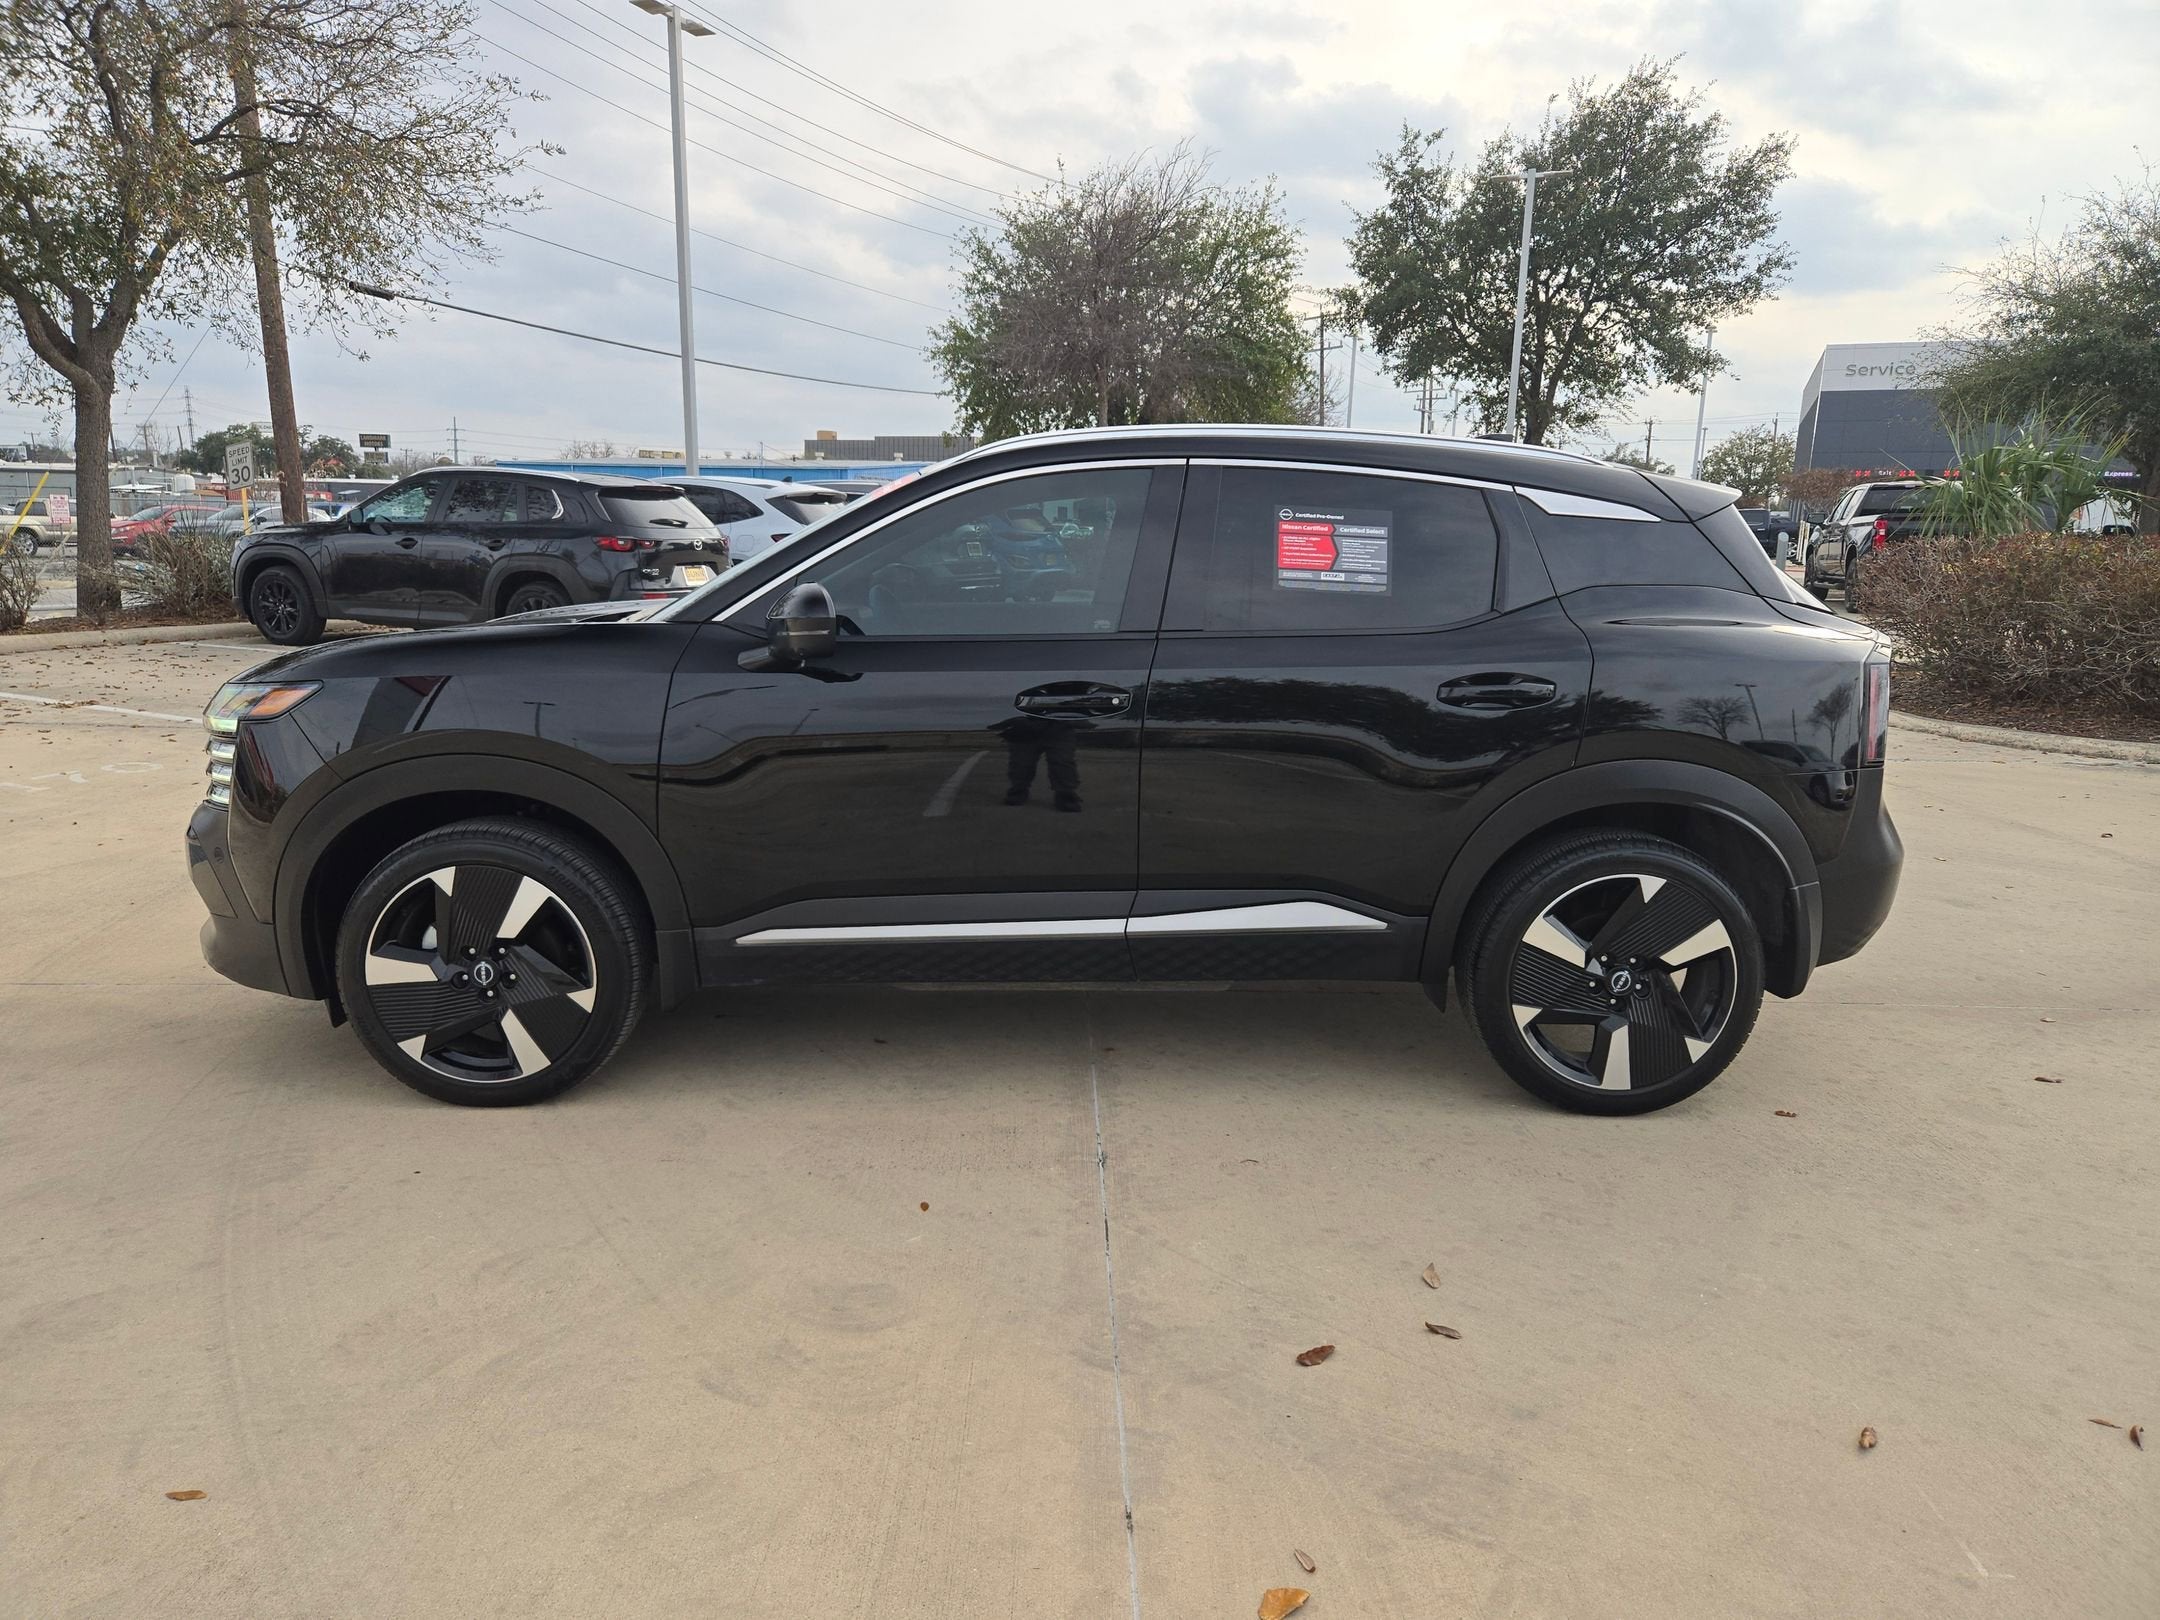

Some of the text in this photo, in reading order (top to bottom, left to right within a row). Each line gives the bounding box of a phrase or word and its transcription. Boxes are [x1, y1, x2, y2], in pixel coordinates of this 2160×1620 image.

[1845, 362, 1916, 376] Service
[228, 446, 250, 458] SPEED
[231, 456, 248, 466] LIMIT
[231, 466, 251, 484] 30
